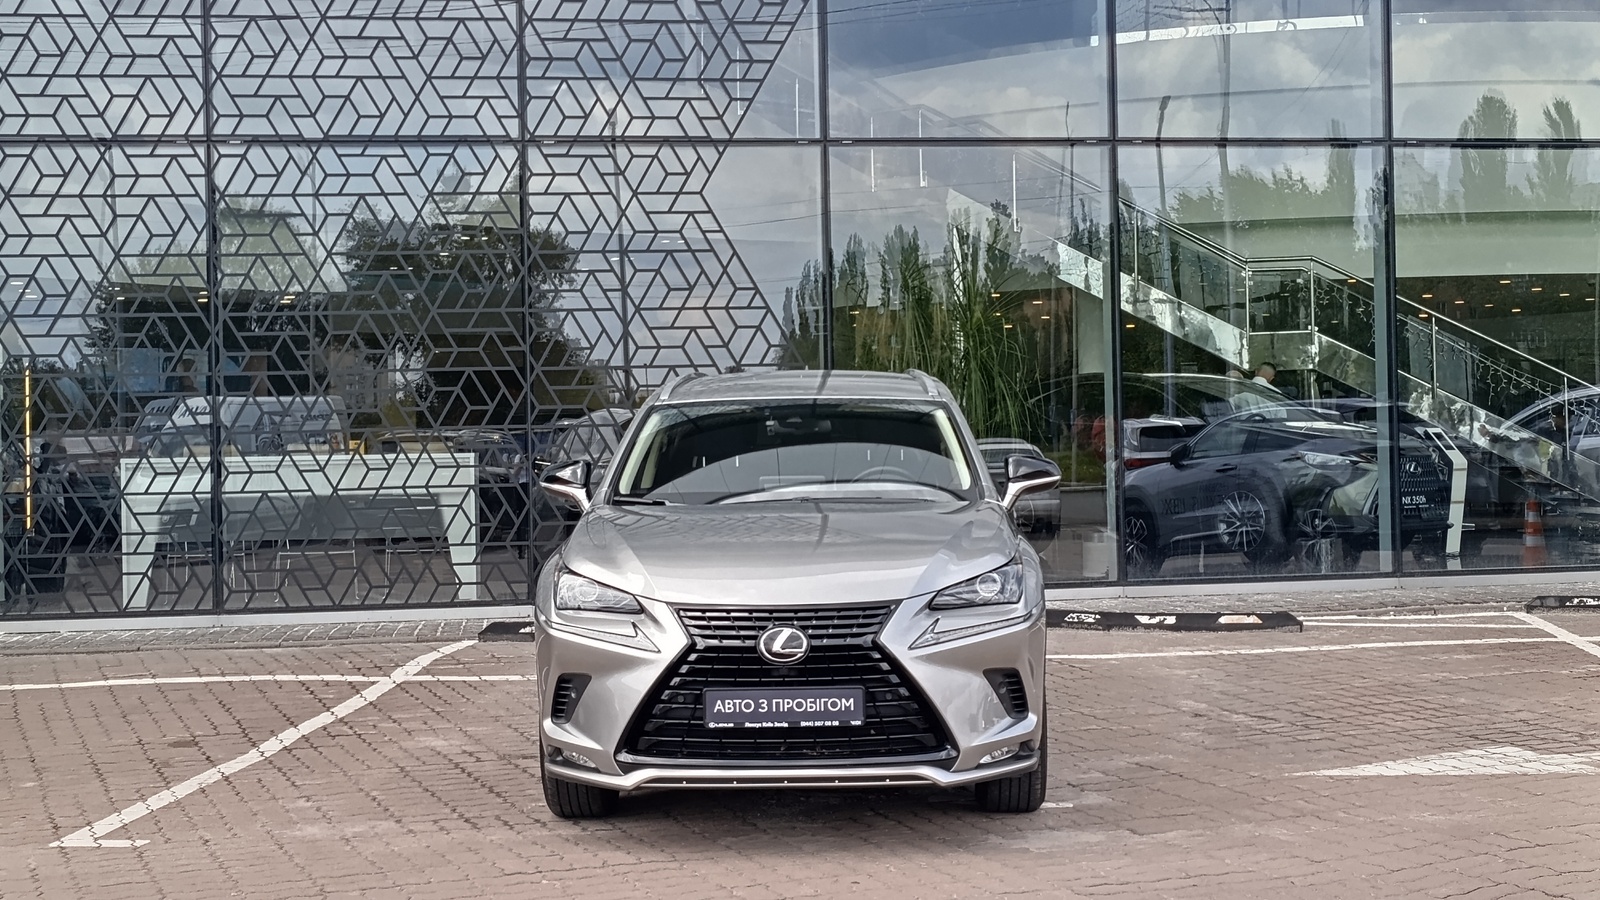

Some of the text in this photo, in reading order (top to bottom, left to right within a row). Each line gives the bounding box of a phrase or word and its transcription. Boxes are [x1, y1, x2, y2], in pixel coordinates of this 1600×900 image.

[1402, 496, 1411, 504] NX
[713, 699, 755, 713] АВТО
[772, 698, 854, 713] ПРОБІГОМ
